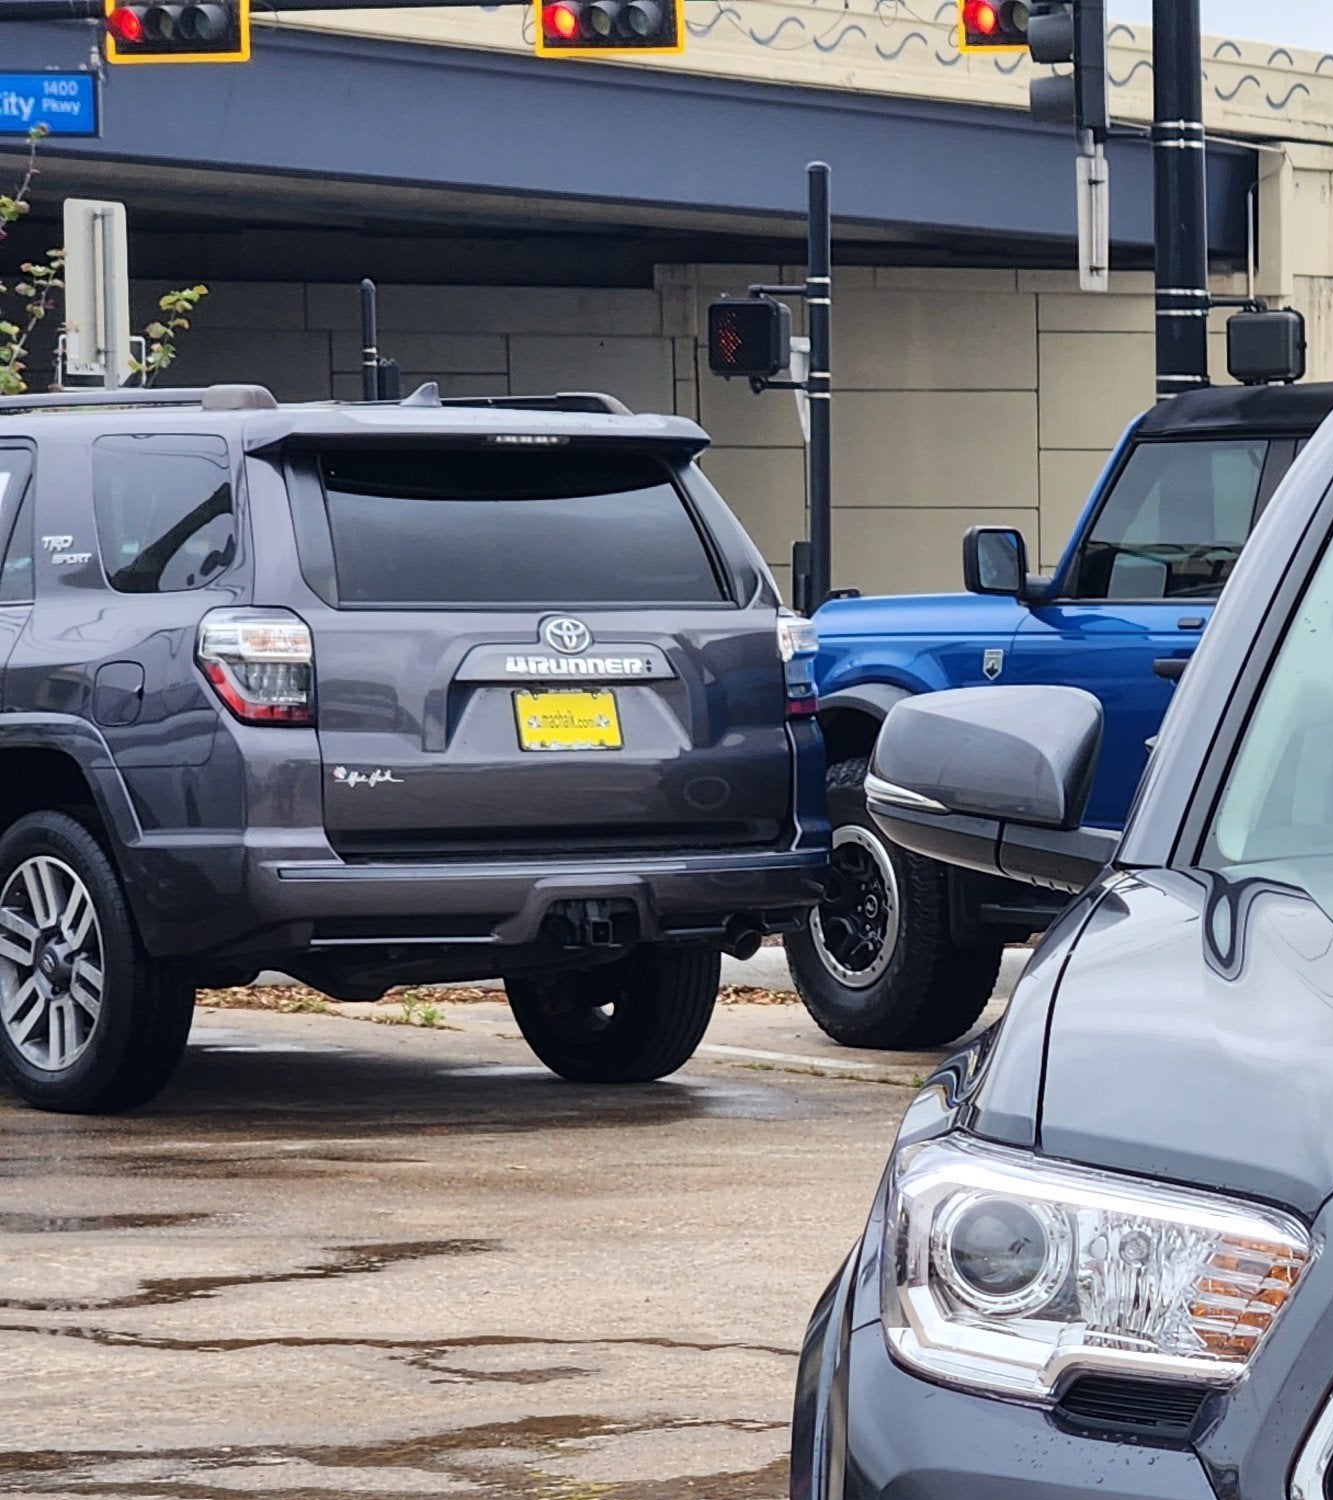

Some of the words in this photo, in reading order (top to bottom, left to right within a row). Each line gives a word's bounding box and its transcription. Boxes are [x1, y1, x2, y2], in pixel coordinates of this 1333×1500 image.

[43, 80, 79, 96] 1400
[0, 91, 36, 121] ity
[41, 98, 81, 116] Pkwy
